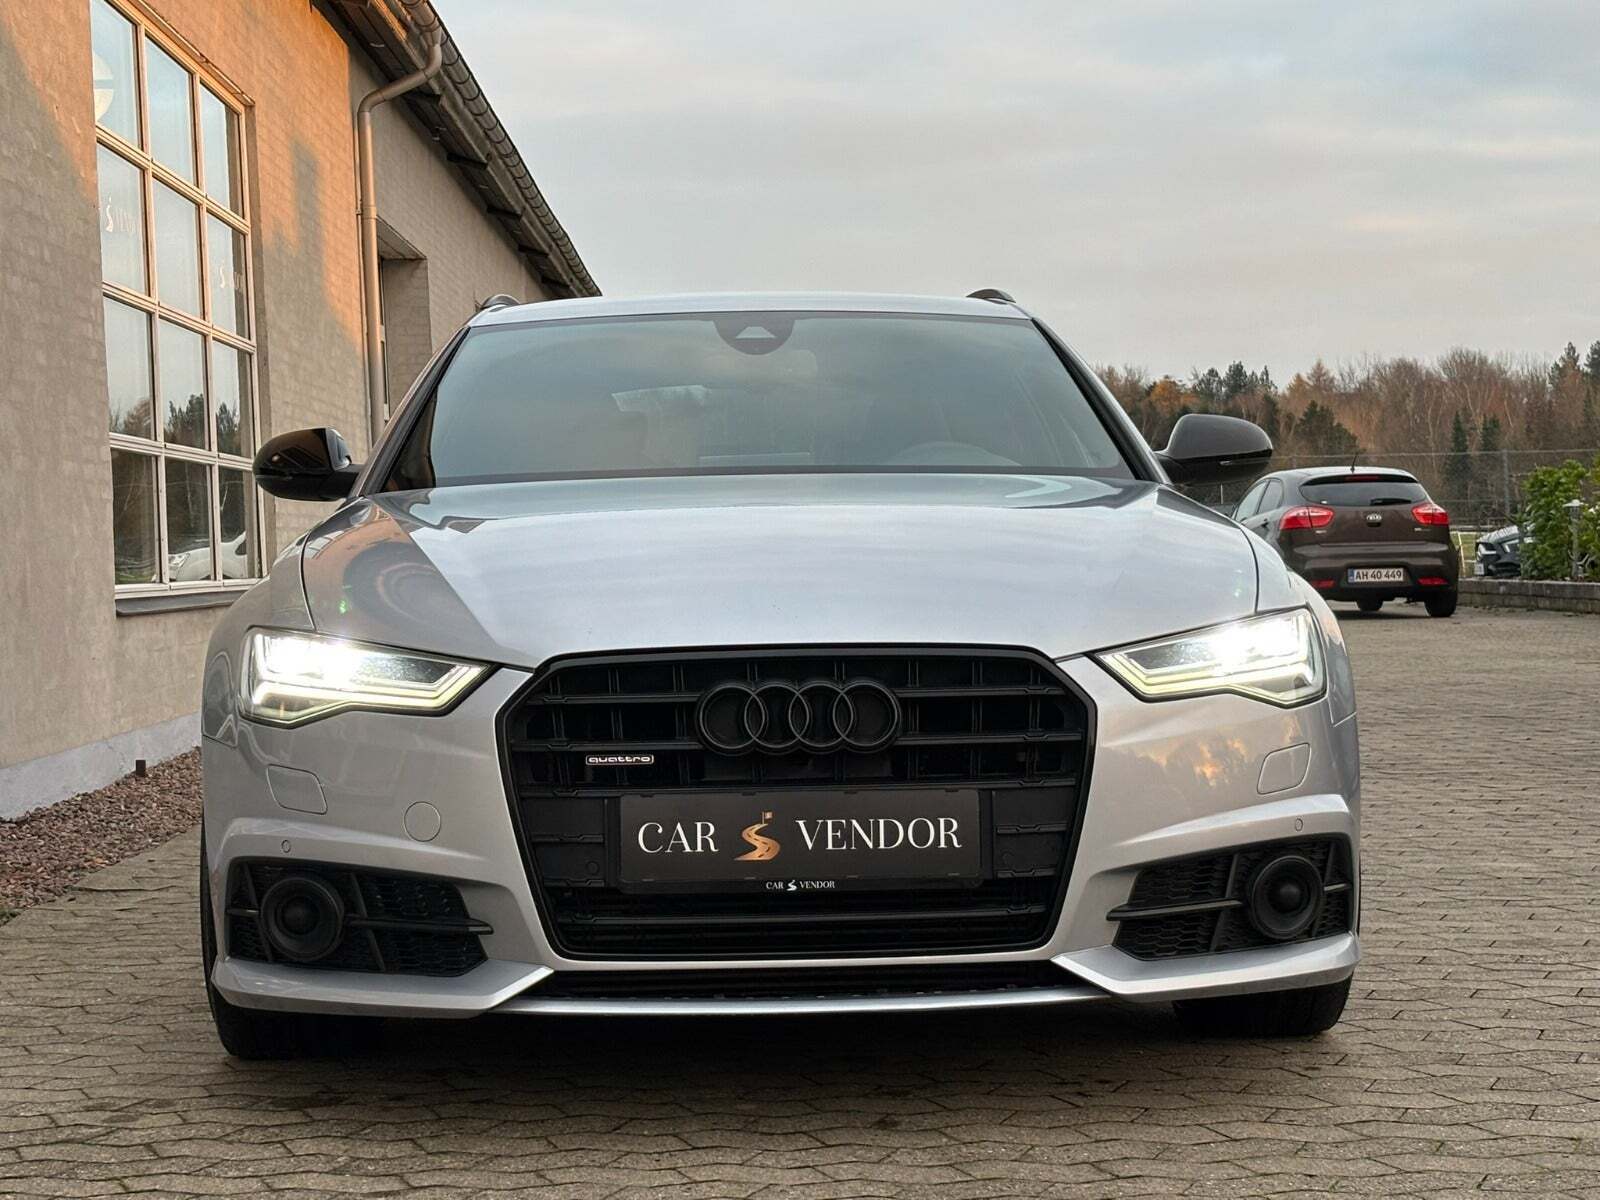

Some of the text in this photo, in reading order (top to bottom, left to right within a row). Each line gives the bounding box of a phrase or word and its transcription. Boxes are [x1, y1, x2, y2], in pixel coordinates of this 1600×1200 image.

[1355, 569, 1368, 580] AH
[1370, 569, 1382, 580] 40
[1384, 569, 1402, 579] 449
[588, 756, 650, 764] quattro
[637, 817, 962, 853] CAR VENDOR
[765, 880, 835, 890] CAR VENDOR
